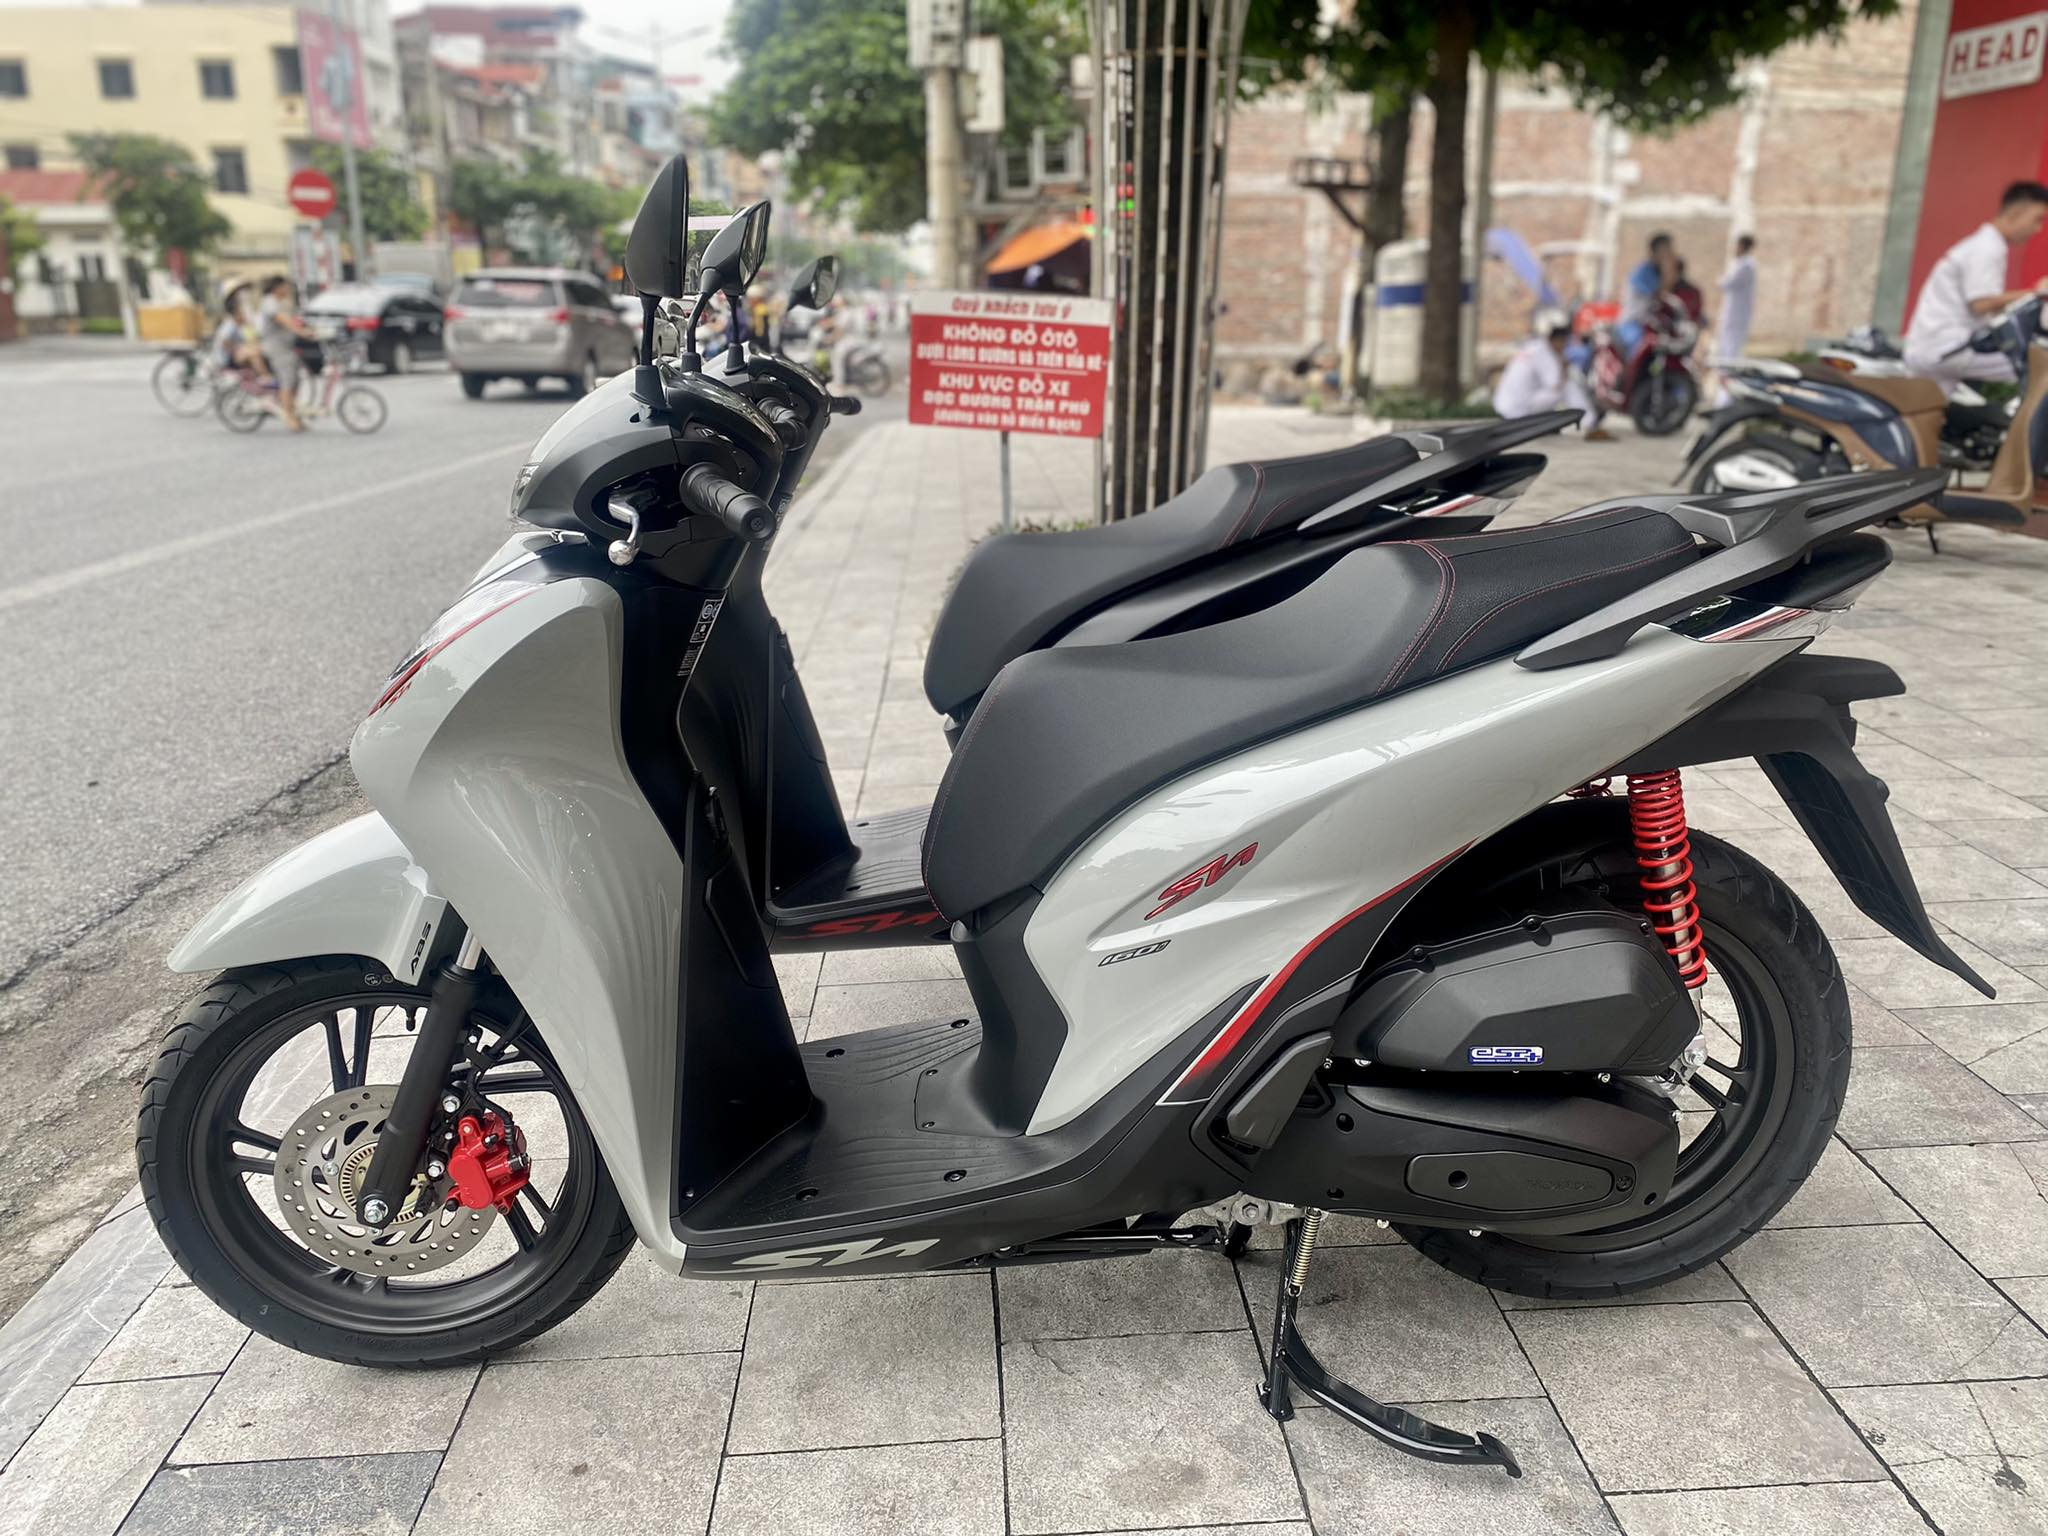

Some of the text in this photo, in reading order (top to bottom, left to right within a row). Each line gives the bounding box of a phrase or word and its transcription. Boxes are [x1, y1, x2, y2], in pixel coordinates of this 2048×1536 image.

[1951, 26, 2039, 75] HEAD
[984, 299, 1029, 316] khách
[943, 322, 1078, 349] KHÔNG ĐỖ ÔTÔ
[939, 372, 1070, 397] KHU VỰC ĐỖ XE
[410, 921, 432, 976] ABS
